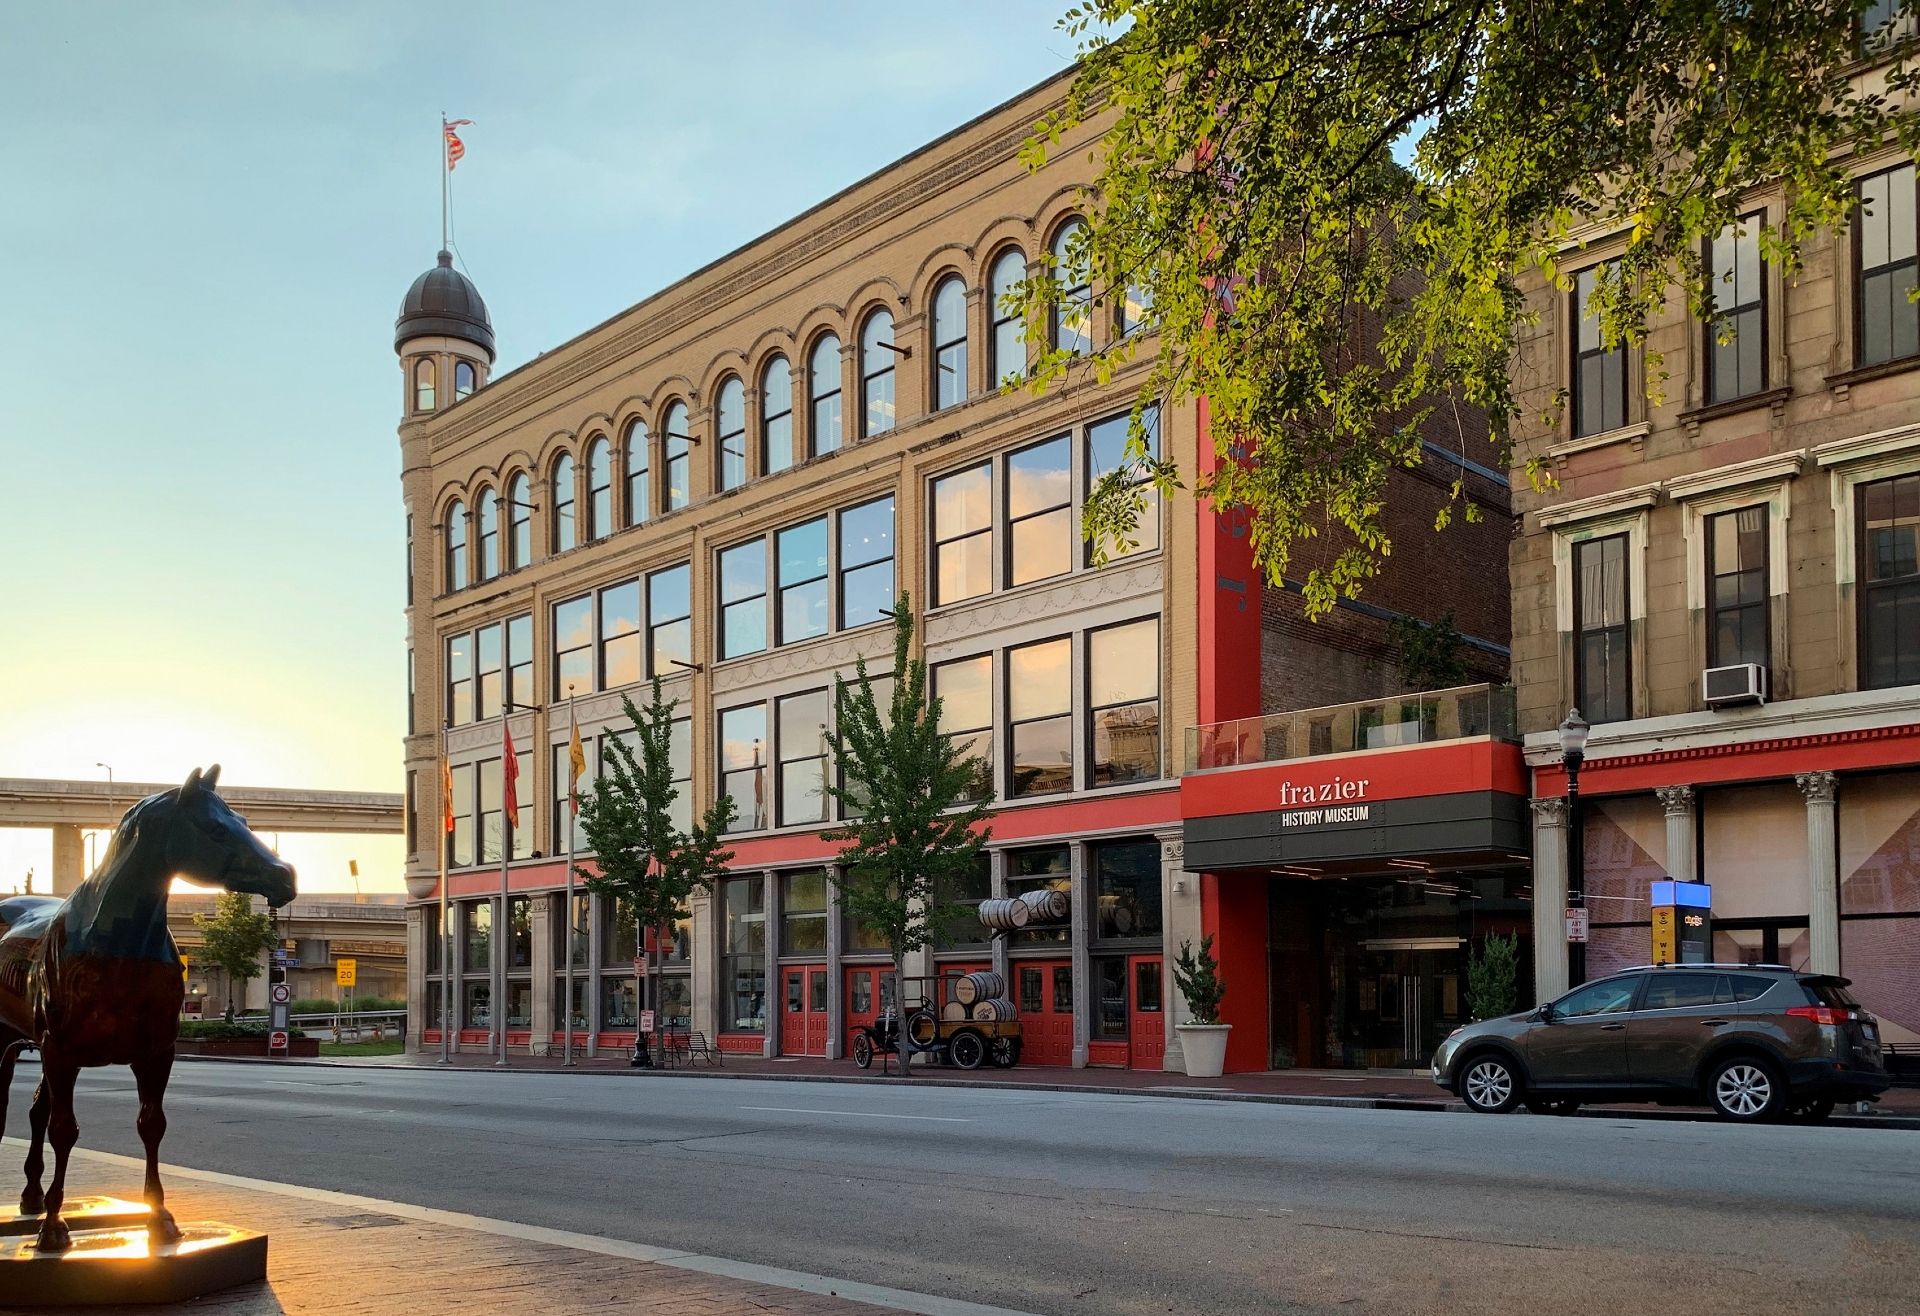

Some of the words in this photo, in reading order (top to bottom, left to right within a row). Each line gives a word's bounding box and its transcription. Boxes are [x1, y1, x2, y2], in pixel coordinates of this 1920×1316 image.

[1280, 776, 1369, 805] frazier
[1282, 810, 1323, 827] HISTORY
[1325, 806, 1369, 823] MUSEUM
